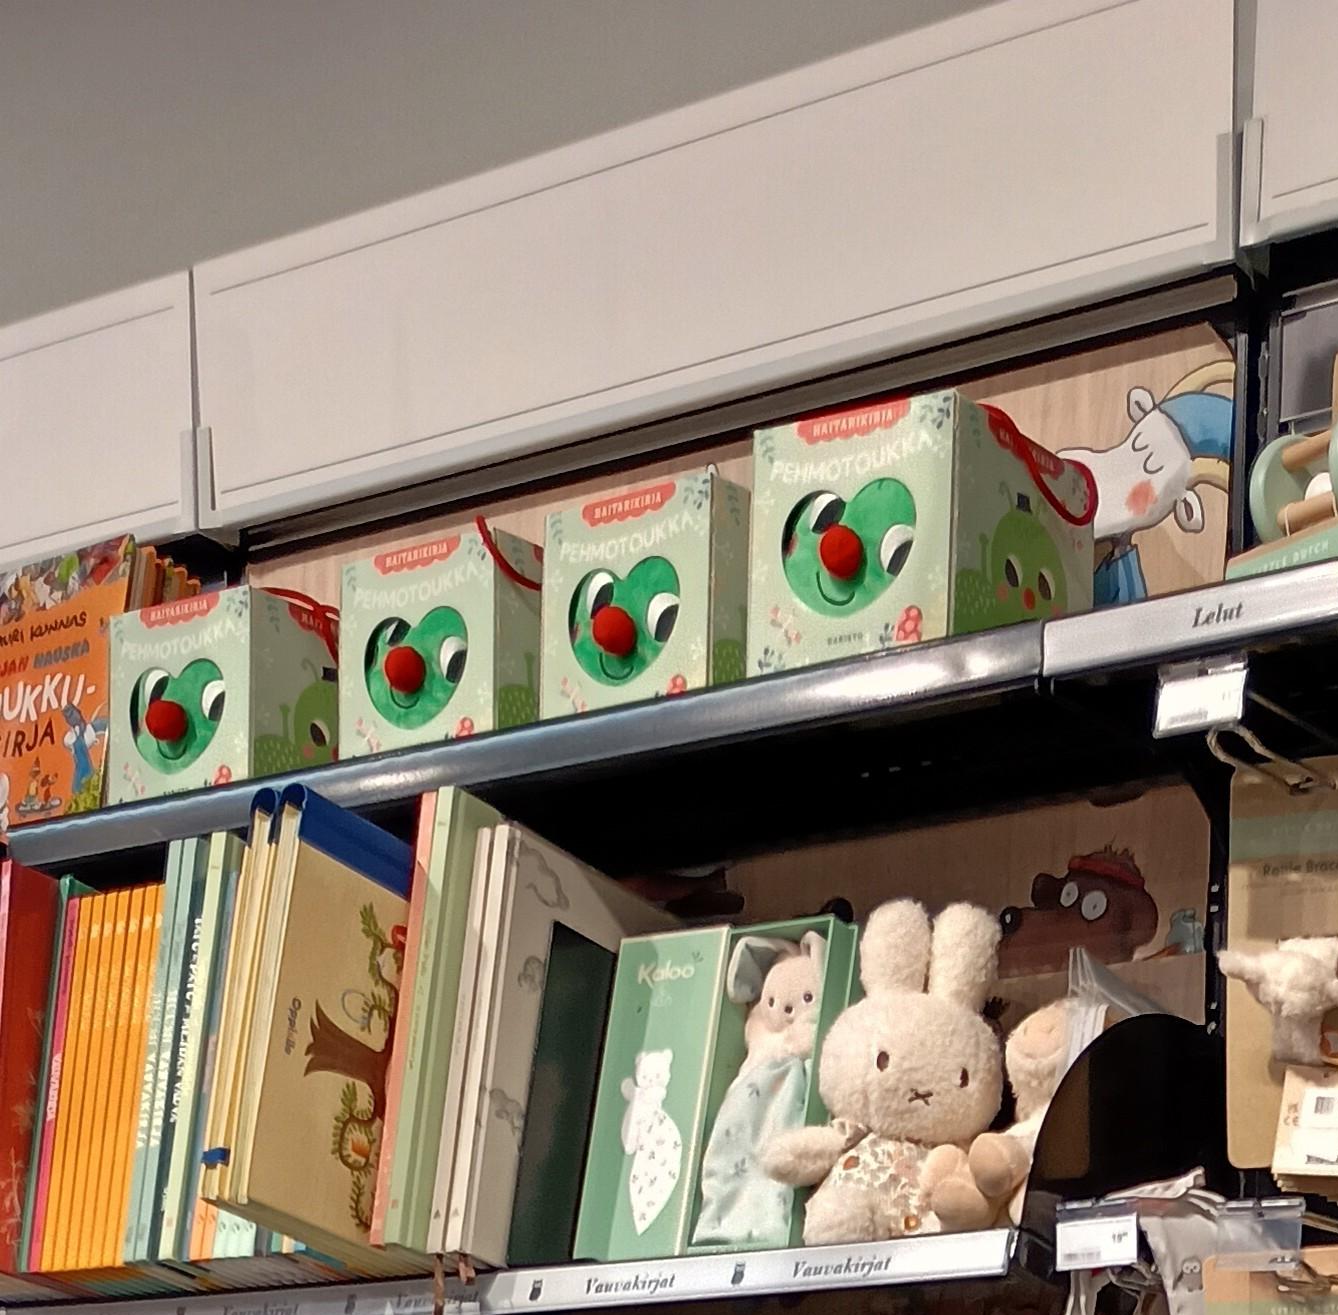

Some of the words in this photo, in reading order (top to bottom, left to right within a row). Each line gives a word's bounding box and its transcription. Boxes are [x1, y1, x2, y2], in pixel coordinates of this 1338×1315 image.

[770, 429, 934, 484] PEHMOTOUKKA
[560, 513, 698, 564] PEHMOTOUKKA
[354, 562, 480, 609] PEHMOTOUKKA
[1191, 601, 1244, 629] Lelut
[120, 617, 236, 662] PEHMOTOUKKA
[638, 961, 695, 988] Kaloo
[585, 1271, 676, 1297] Vauvakirjat
[792, 1254, 893, 1280] Vauvakirjat
